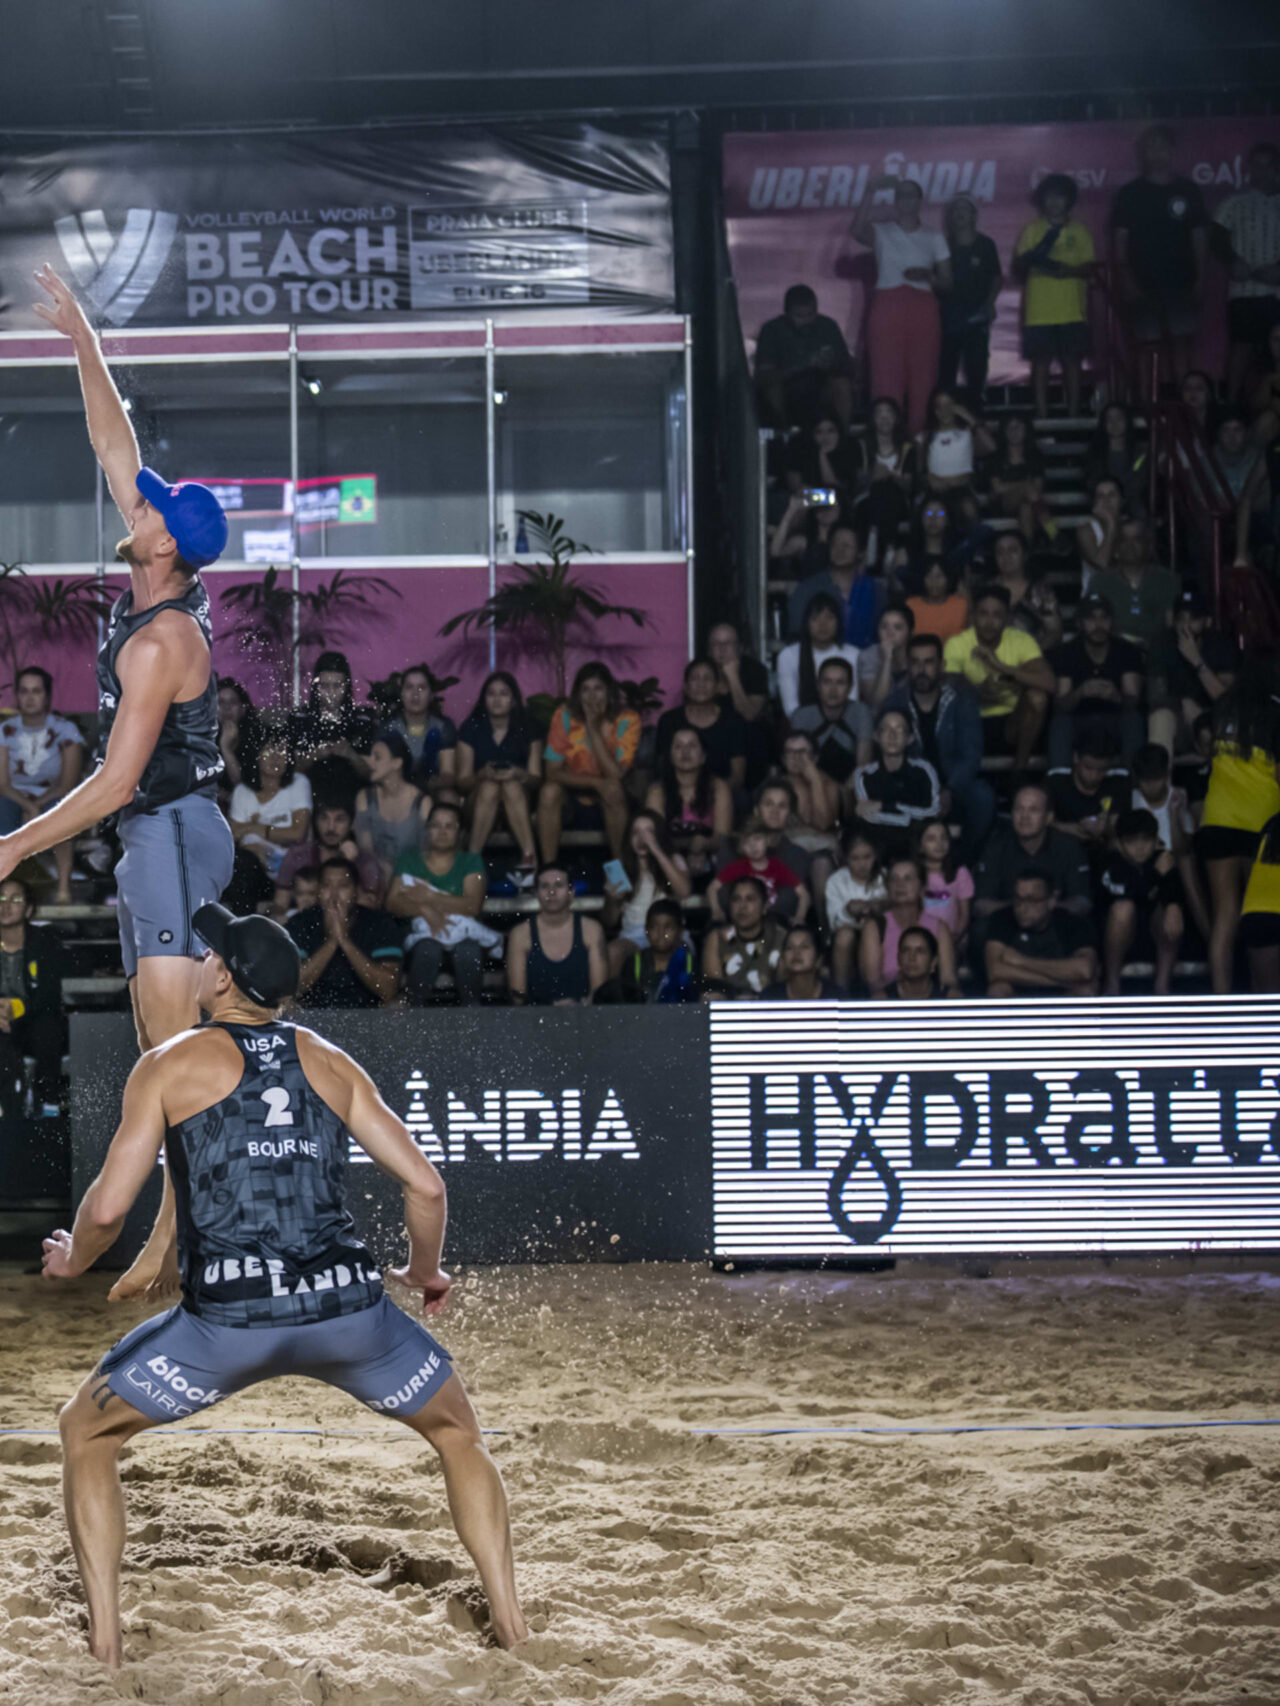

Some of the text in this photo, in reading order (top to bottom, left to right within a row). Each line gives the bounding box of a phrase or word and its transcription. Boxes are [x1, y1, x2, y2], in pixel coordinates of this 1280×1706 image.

[185, 205, 397, 228] VOLLEYBALL WORLD
[426, 213, 495, 233] PRAIA
[185, 226, 399, 280] BEACH
[187, 278, 399, 318] PRO TOUR
[243, 1035, 286, 1052] USA
[261, 1086, 294, 1127] 2
[349, 1070, 640, 1162] ÂNDIA
[248, 1139, 318, 1158] BOURNE
[126, 1366, 193, 1416] LAIRD
